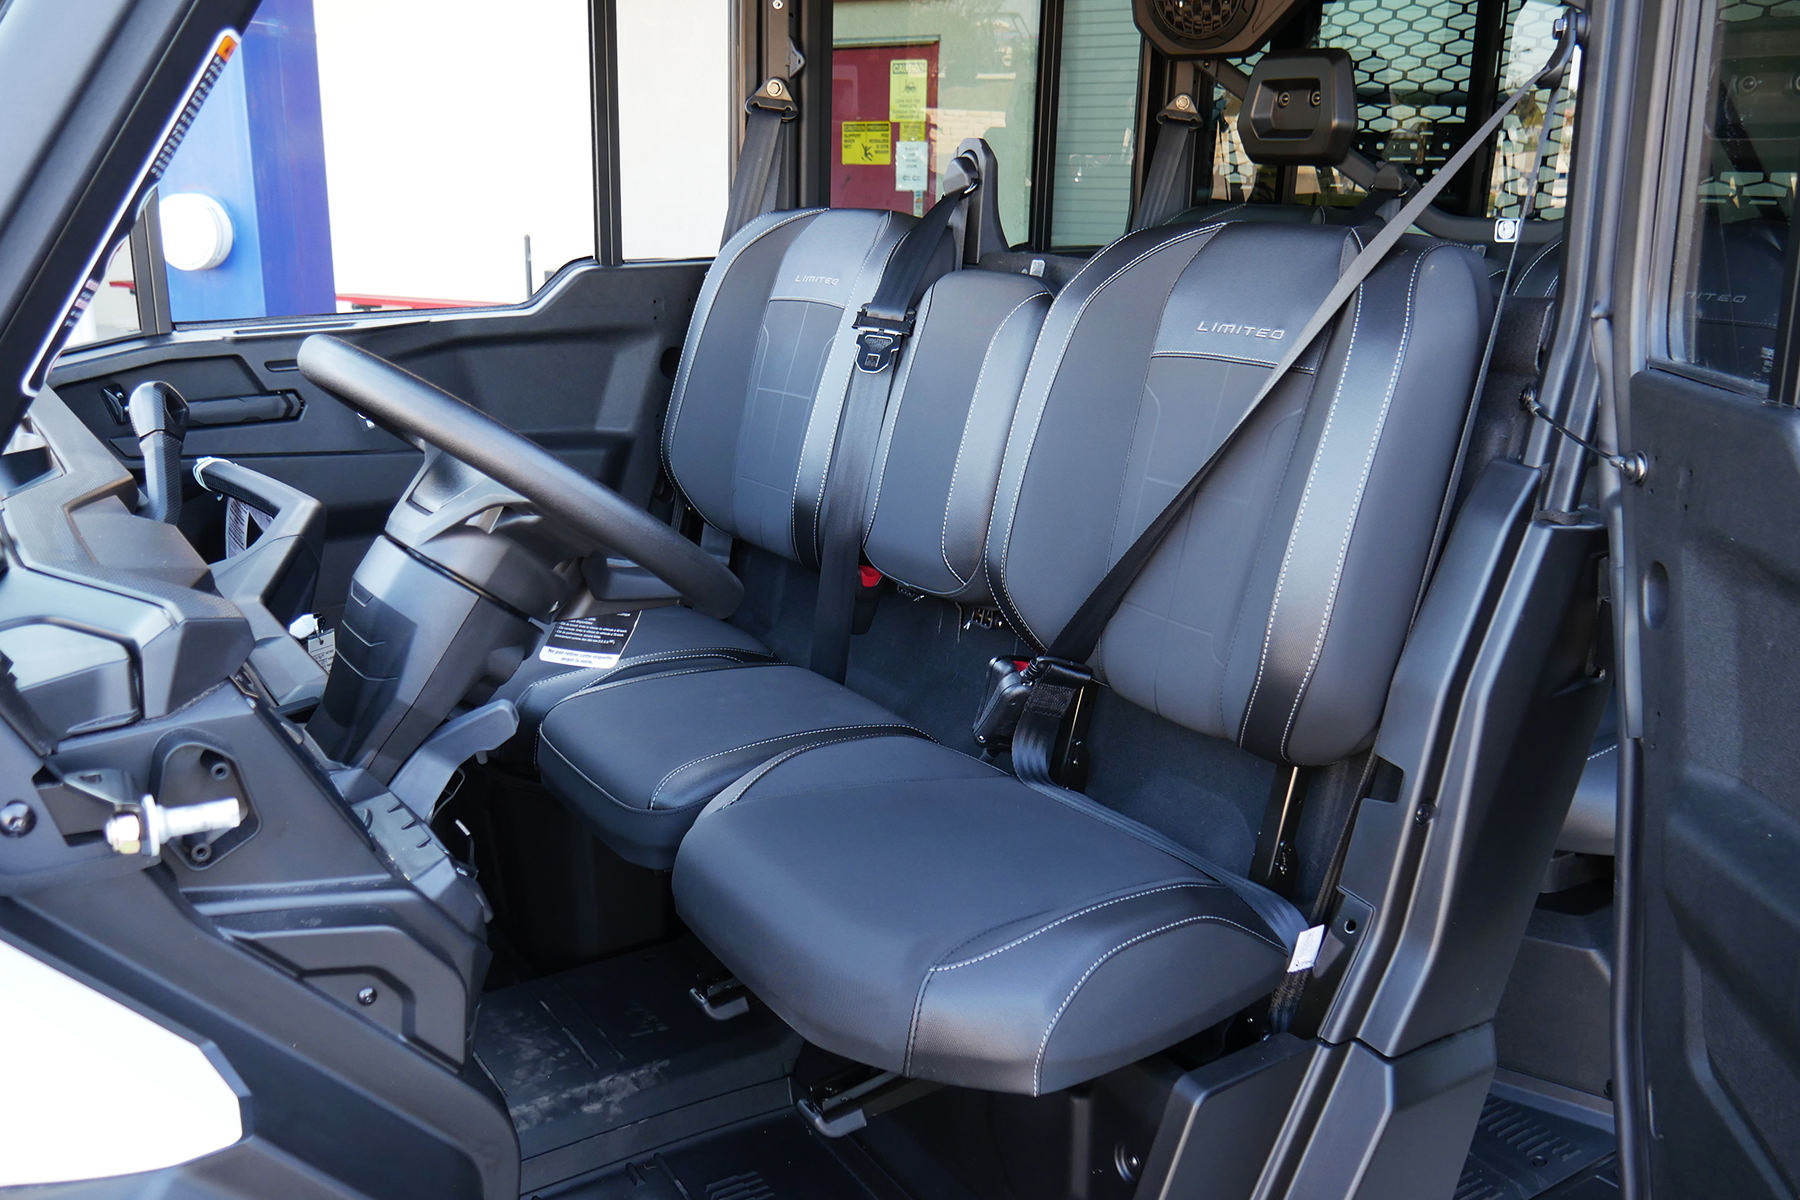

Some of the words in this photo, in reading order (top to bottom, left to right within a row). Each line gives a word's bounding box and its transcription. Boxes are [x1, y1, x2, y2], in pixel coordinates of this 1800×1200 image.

[893, 63, 926, 74] CAUTION
[795, 275, 839, 286] LIMITED
[1196, 321, 1285, 340] LIMITED
